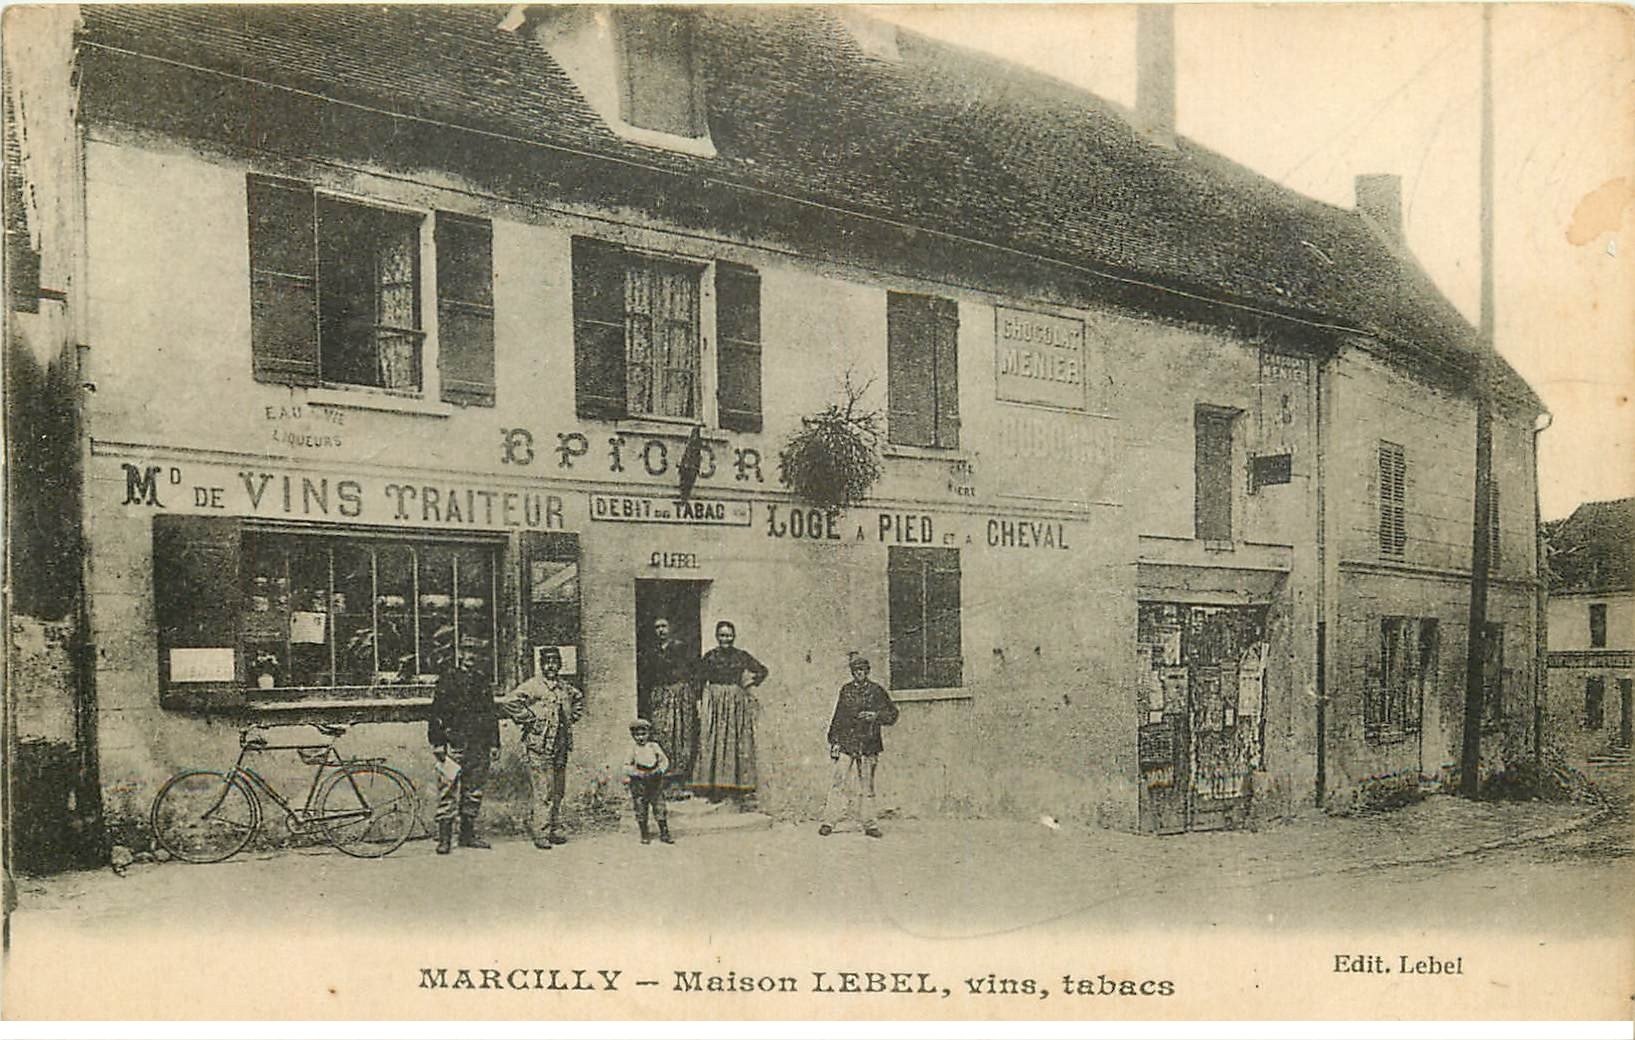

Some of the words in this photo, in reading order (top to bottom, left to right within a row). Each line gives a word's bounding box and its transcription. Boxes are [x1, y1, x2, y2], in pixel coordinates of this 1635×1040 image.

[1001, 348, 1081, 385] MENIER
[264, 405, 302, 421] EAU
[193, 486, 225, 509] DE
[238, 471, 364, 518] VINS
[384, 481, 566, 530] TRAITEUR
[595, 497, 652, 518] DEBIT
[672, 500, 726, 521] TABAC
[765, 504, 842, 541] LOGE
[878, 513, 934, 545] PIED
[986, 518, 1070, 551] CHEVAL
